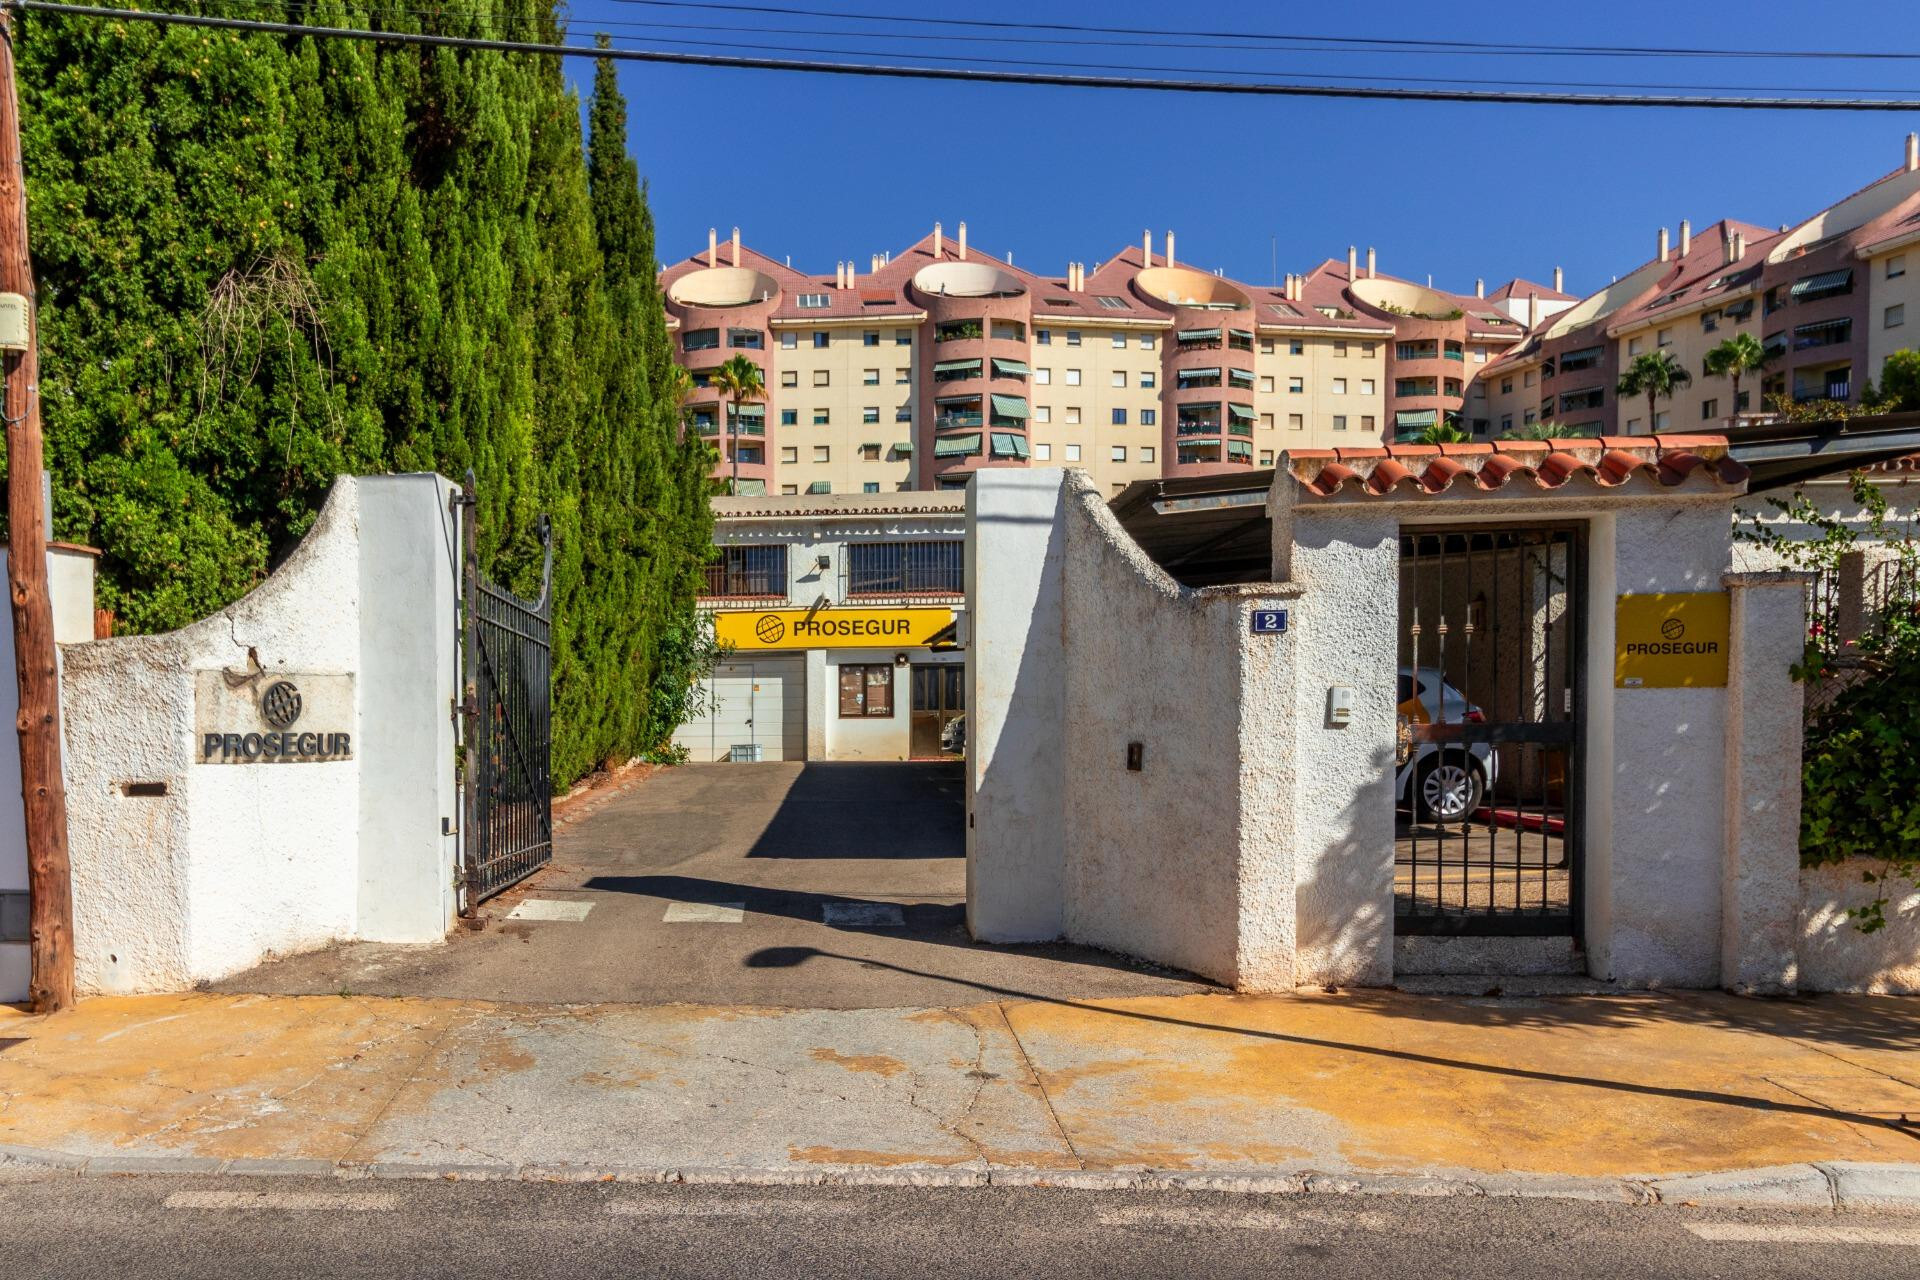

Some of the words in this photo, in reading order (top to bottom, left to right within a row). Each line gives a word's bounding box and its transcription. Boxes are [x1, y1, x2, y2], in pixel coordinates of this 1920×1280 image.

[793, 619, 911, 636] PROSEGUR
[1264, 613, 1277, 629] 2
[1626, 641, 1718, 655] PROSEGUR
[204, 732, 351, 758] PROSEGUR
